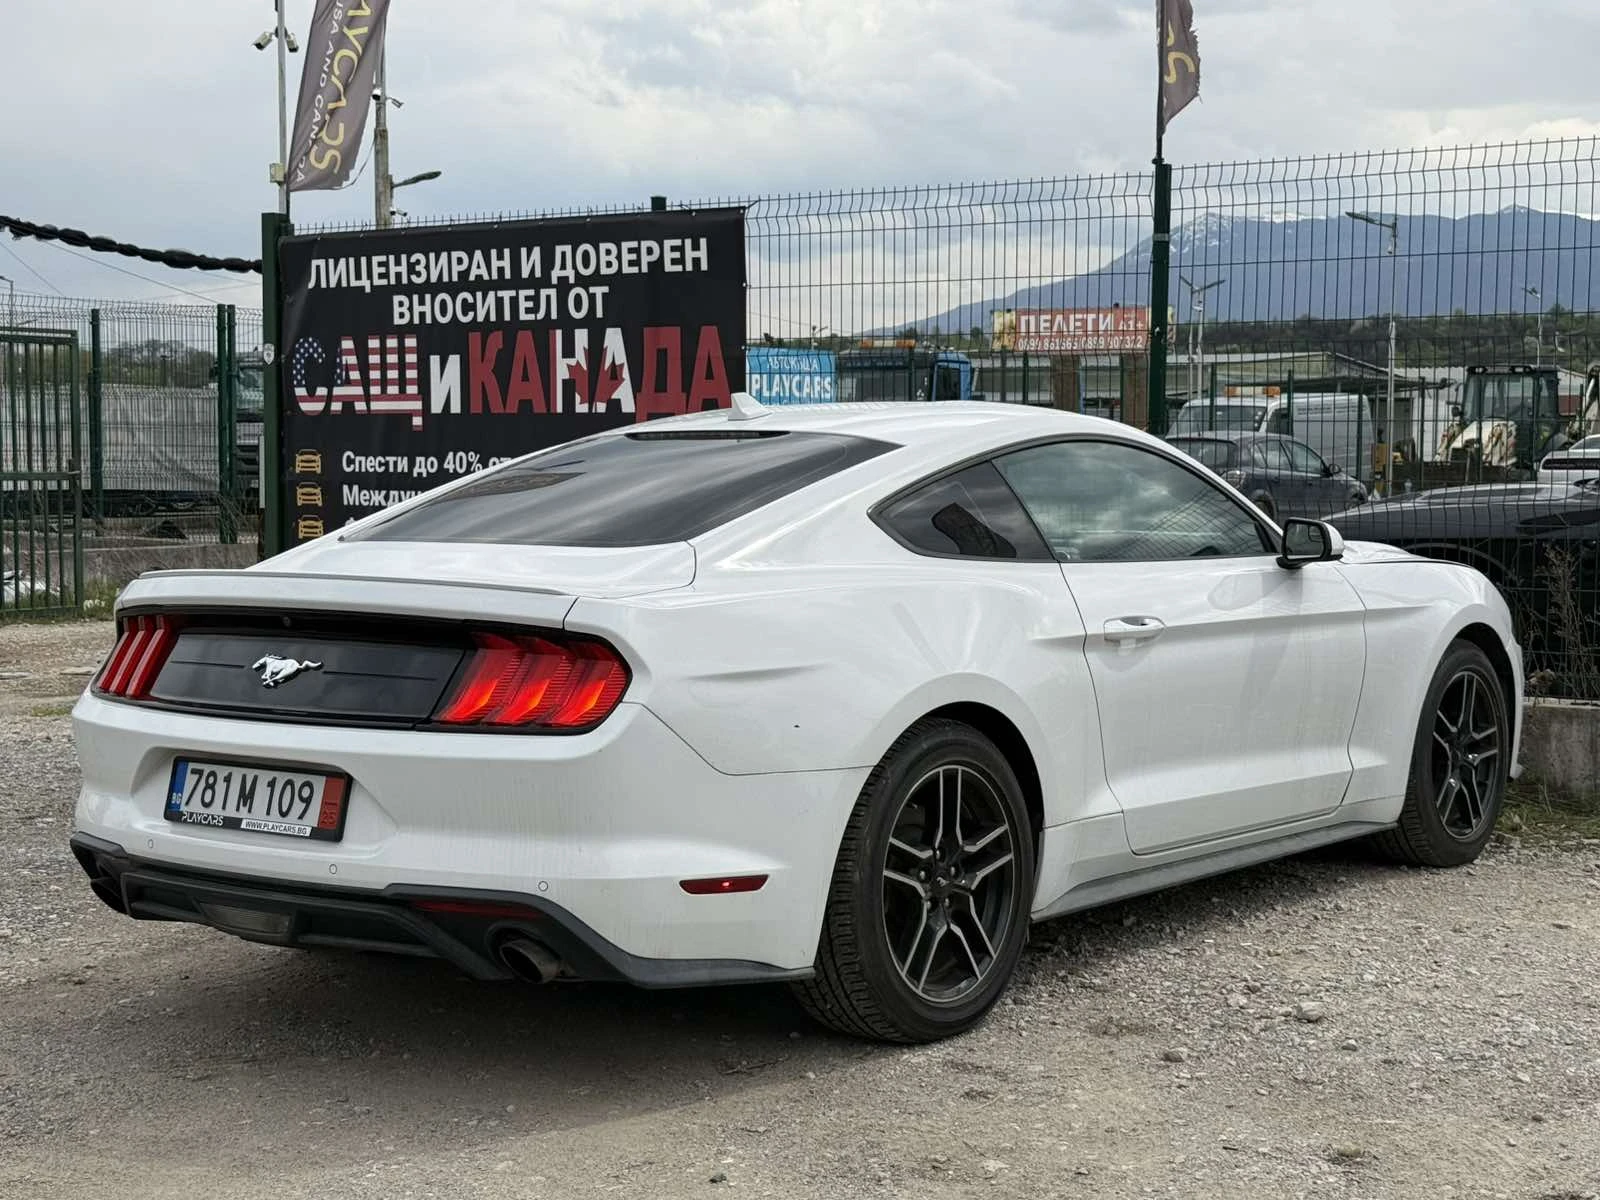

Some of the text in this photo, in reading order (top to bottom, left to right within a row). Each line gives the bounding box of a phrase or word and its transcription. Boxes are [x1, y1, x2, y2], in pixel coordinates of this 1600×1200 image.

[320, 41, 335, 88] AND
[308, 238, 708, 293] ЛИЦЕНЗИРАН И ДОВЕРЕН
[392, 286, 609, 325] ВНОСИТЕЛ ОТ
[1019, 313, 1113, 335] ПЕЛЕТИ
[292, 325, 731, 432] САЩ и КАНАДА
[751, 373, 831, 399] PLAYCARS
[342, 451, 408, 473] Спести
[412, 455, 438, 477] до
[443, 451, 482, 474] 40%
[185, 768, 315, 820] 781 M 109
[181, 811, 224, 827] PLAYCARS
